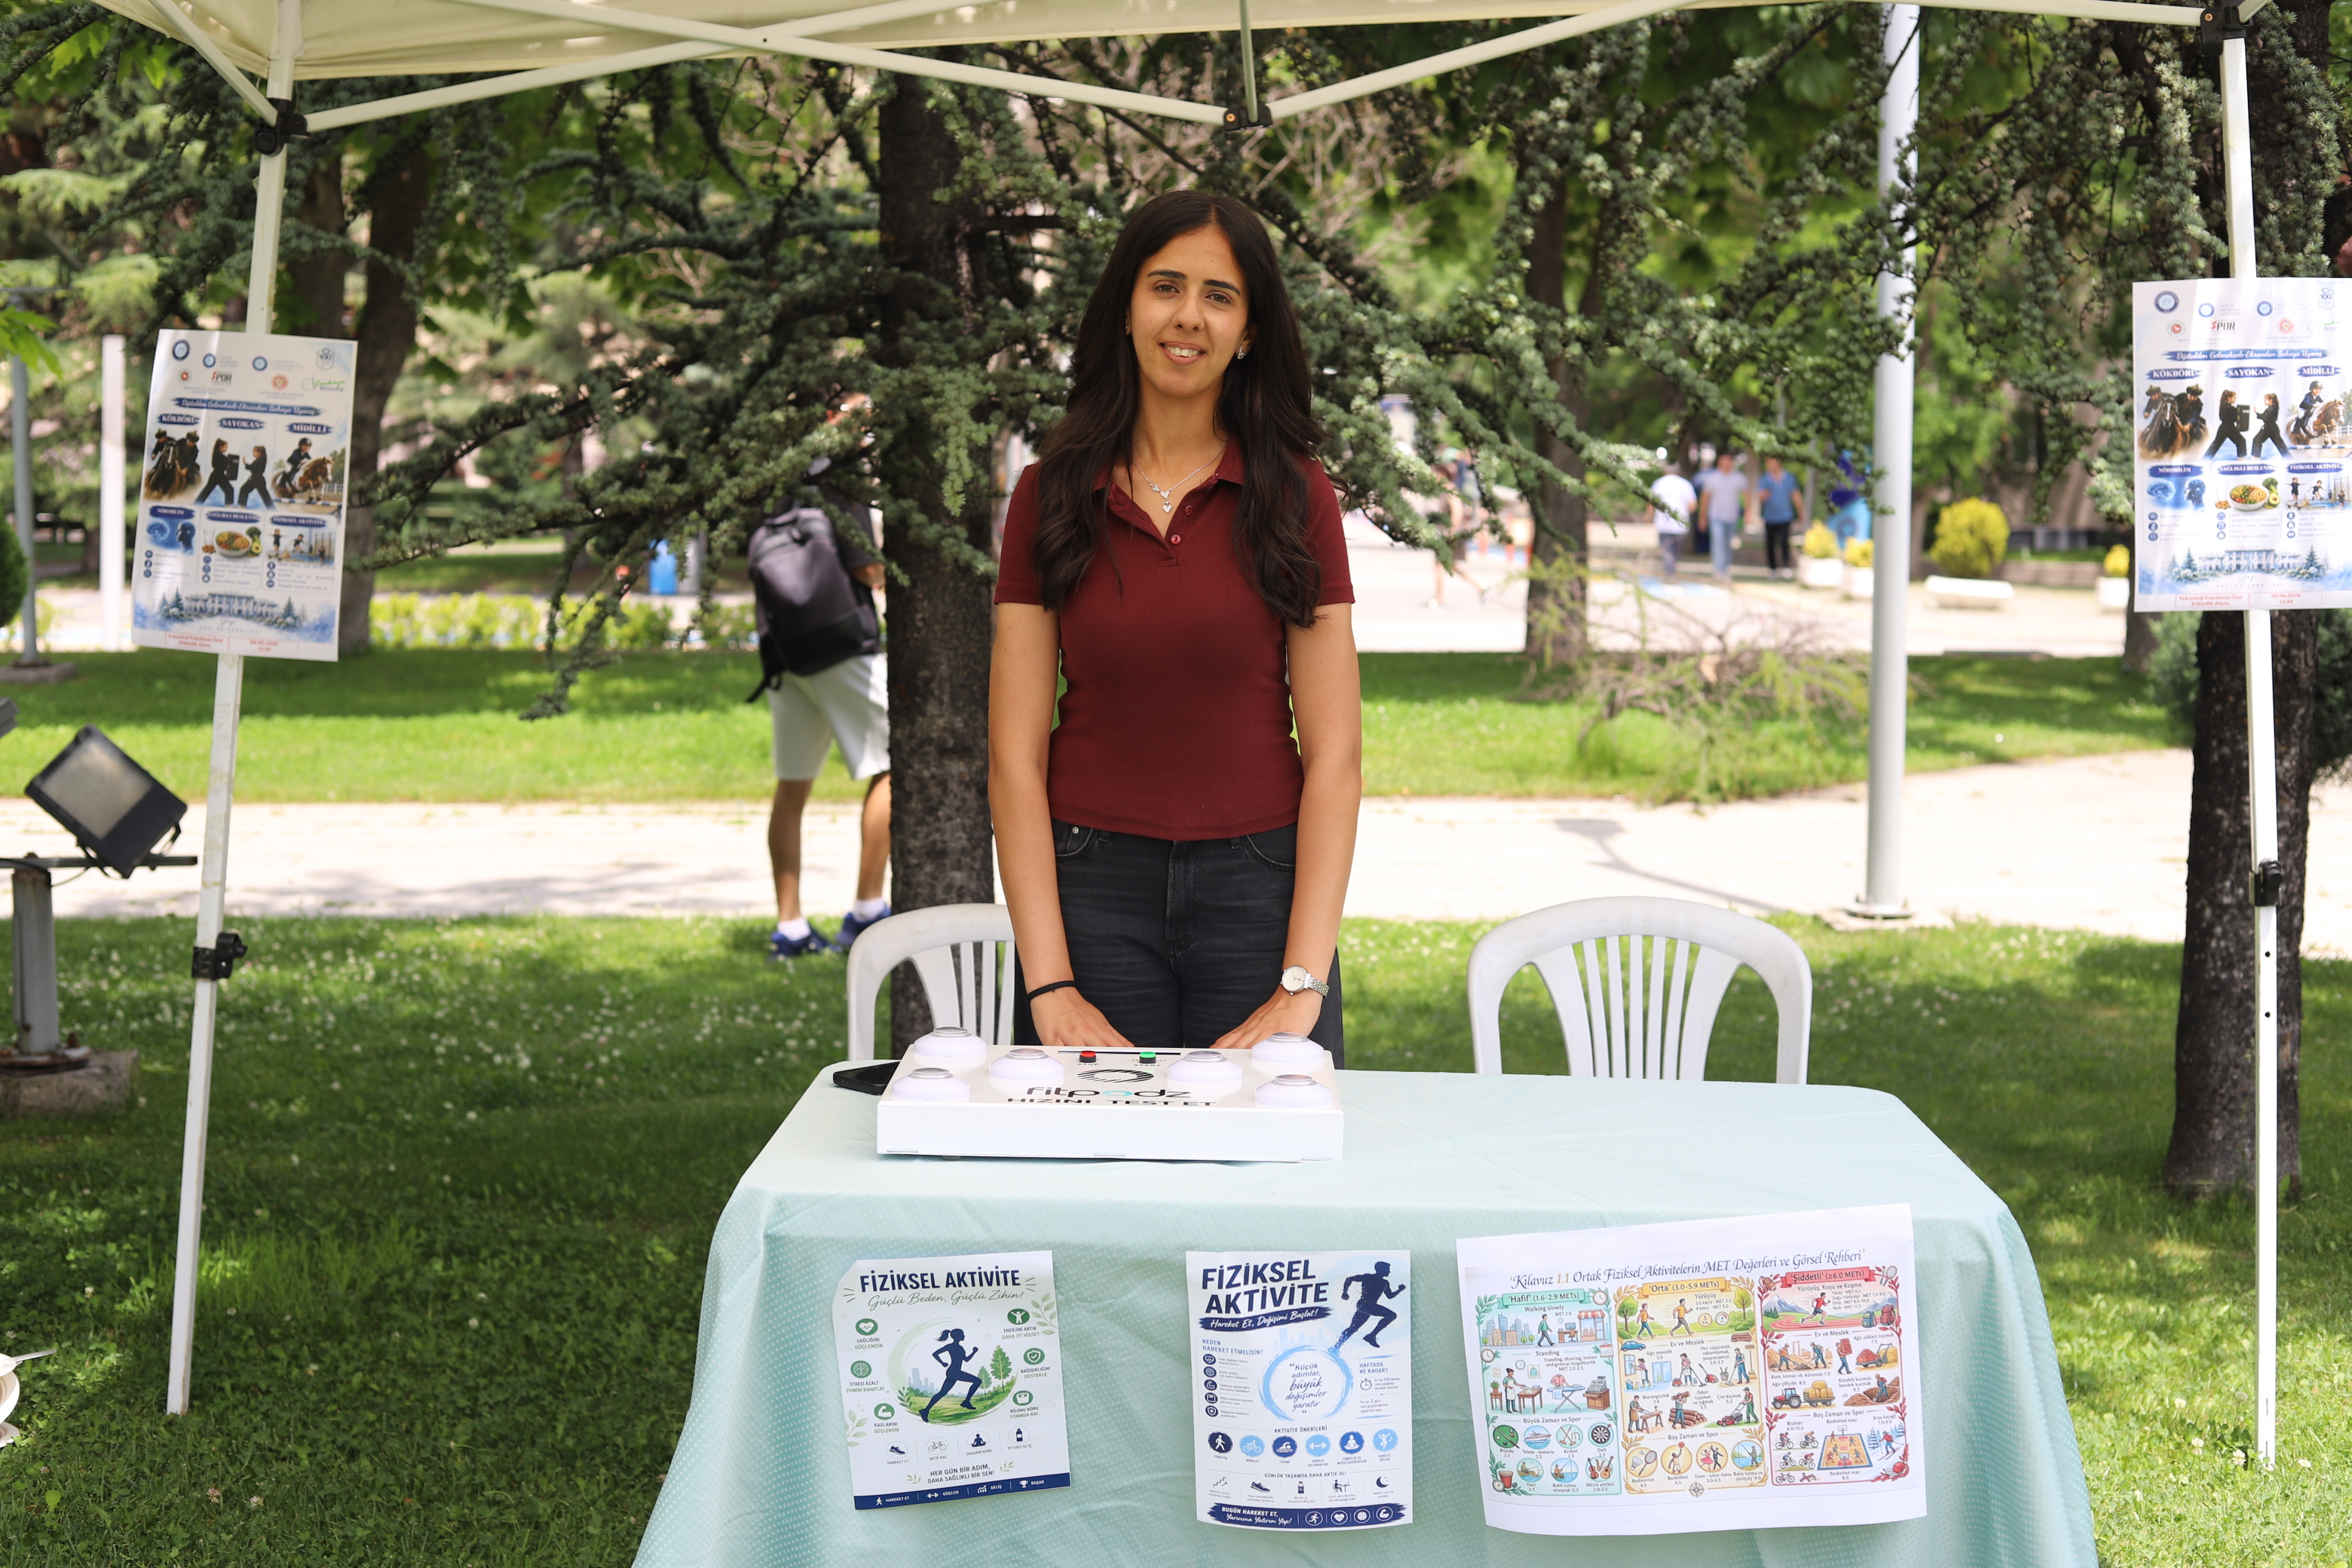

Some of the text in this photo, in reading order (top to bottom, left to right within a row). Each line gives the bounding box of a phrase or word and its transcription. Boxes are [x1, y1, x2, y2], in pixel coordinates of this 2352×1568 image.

[2228, 368, 2270, 377] SAYOKAN
[2302, 366, 2335, 375] MİDİLLİ
[222, 420, 259, 428] SAYOKAN
[1027, 1087, 1191, 1098] fitpodz
[1202, 1260, 1316, 1290] FİZİKSEL
[1557, 1273, 1570, 1284] 1.1
[1573, 1269, 1602, 1282] Ortak
[1603, 1266, 1641, 1283] Fiziksel
[1640, 1261, 1701, 1280] Aktivitelerin
[1702, 1260, 1731, 1274] MET
[1733, 1258, 1778, 1271] Değerleri
[1780, 1258, 1790, 1266] ve
[1793, 1254, 1823, 1269] Görsel
[860, 1266, 1021, 1293] FİZİKSEL AKTİVİTE
[868, 1289, 1024, 1311] Güçlü Beden, Güçlü Zihin!
[1205, 1282, 1329, 1314] AKTİVİTE
[1210, 1308, 1318, 1328] Hareket Et, Değişimi Başlat!
[1290, 1377, 1323, 1392] büyük
[1285, 1390, 1328, 1403] değişimler
[1291, 1401, 1321, 1412] yaratır.
[945, 1473, 969, 1482] SAĞLIKLI
[1279, 1517, 1292, 1526] Yap!
